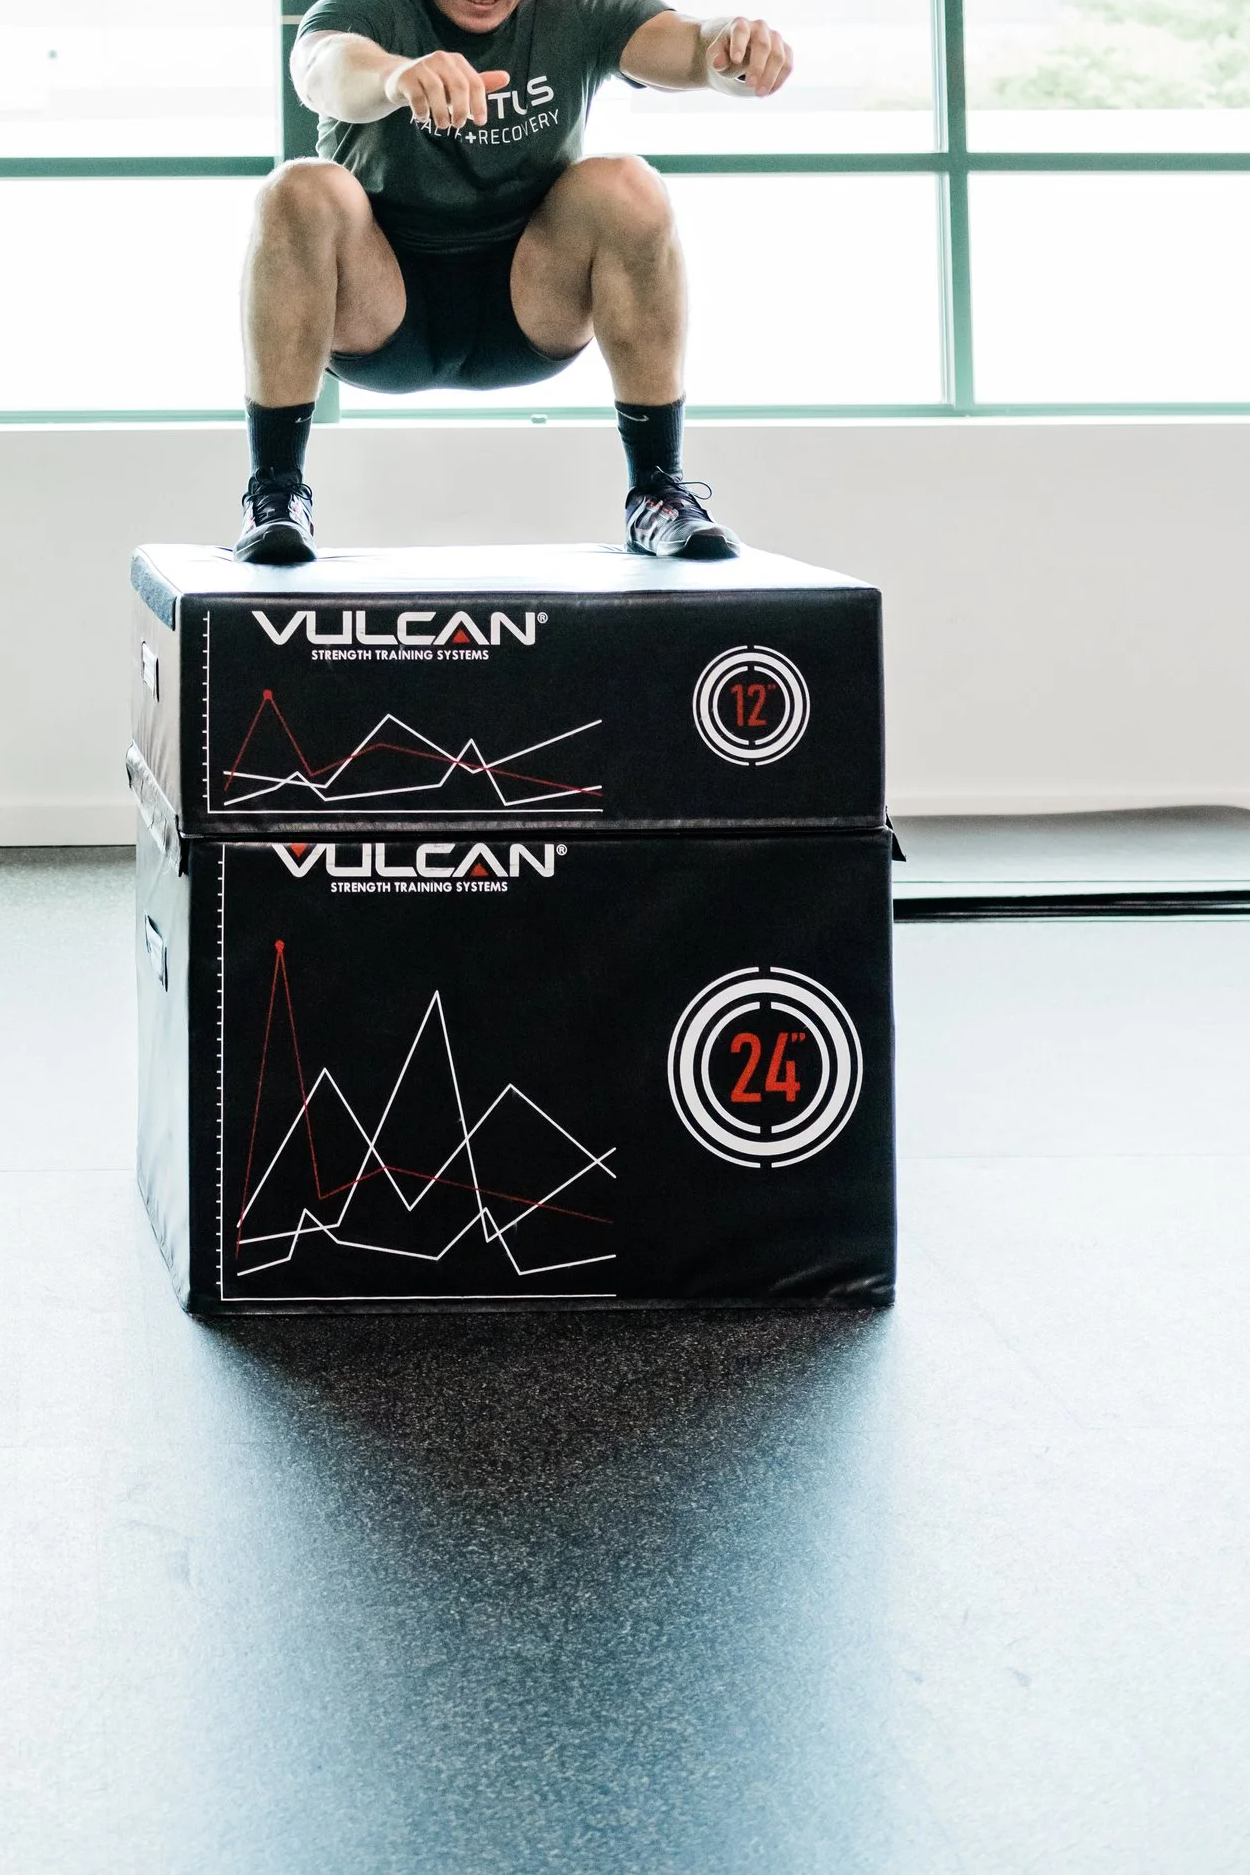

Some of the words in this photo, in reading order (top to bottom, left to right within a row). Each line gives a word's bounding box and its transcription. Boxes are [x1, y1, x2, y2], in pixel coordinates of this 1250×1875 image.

[311, 649, 372, 661] STRENGTH
[375, 649, 434, 661] TRAINING
[436, 649, 490, 661] SYSTEMS
[330, 881, 391, 893] STRENGTH
[394, 881, 453, 893] TRAINING
[455, 880, 508, 893] SYSTEMS
